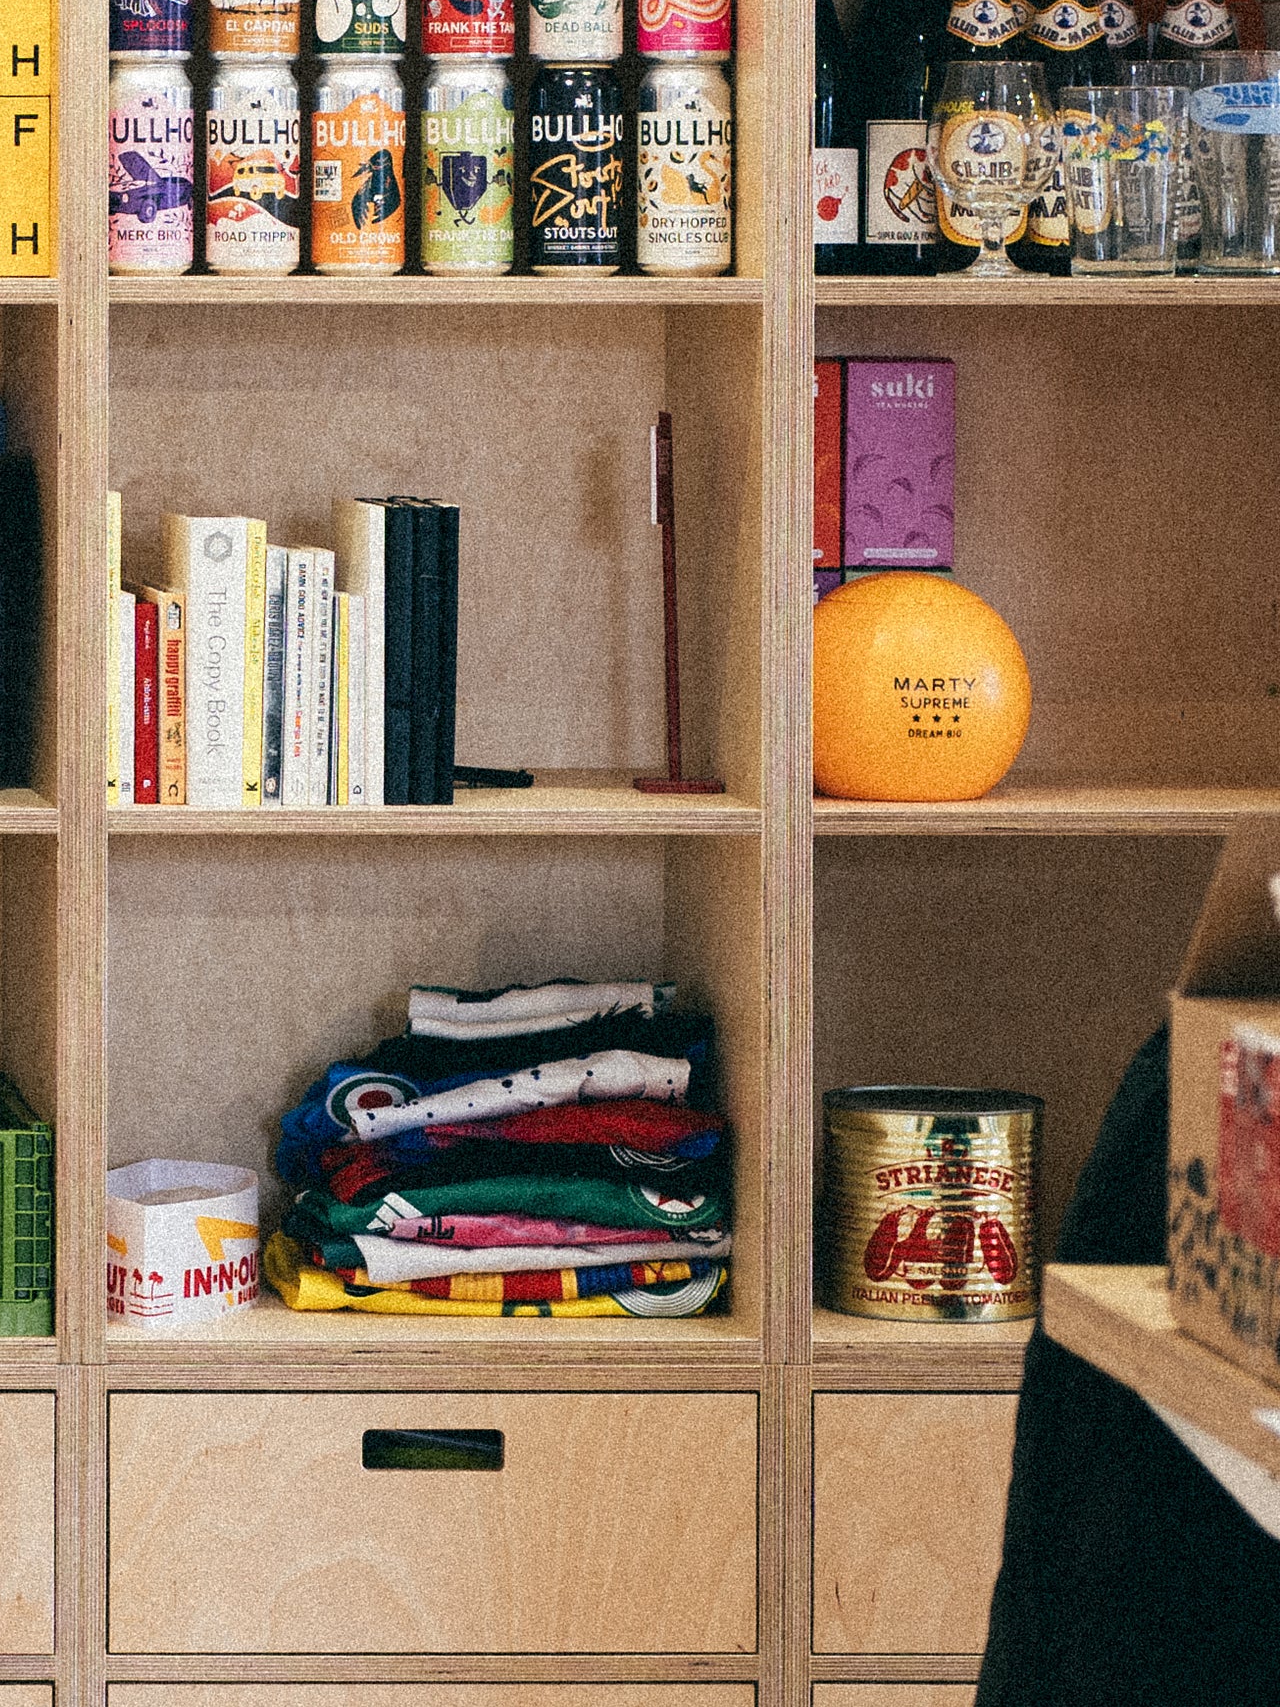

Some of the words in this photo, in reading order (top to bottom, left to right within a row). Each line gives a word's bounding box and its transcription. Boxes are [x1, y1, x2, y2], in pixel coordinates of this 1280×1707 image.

[226, 20, 240, 32] EL
[354, 22, 388, 34] SUDS
[429, 22, 468, 34] FRANK
[472, 22, 497, 34] THE
[545, 22, 579, 33] DEAD
[583, 22, 613, 33] BALL
[14, 114, 39, 147] F
[652, 217, 675, 228] DRY
[680, 217, 727, 228] HOPPED
[117, 229, 152, 241] MERC
[215, 230, 247, 242] ROAD
[330, 232, 355, 244] OLD
[358, 232, 400, 244] CROWS
[544, 227, 595, 239] STOUTS
[649, 232, 702, 243] SINGLES
[871, 373, 935, 398] suki
[208, 587, 228, 627] The
[165, 639, 182, 675] happy
[203, 634, 228, 692] Copy
[893, 677, 976, 691] MARTY
[900, 696, 970, 710] SUPREME
[207, 700, 228, 756] Book
[908, 728, 944, 738] DREAM
[876, 1163, 1015, 1192] STRIANESE
